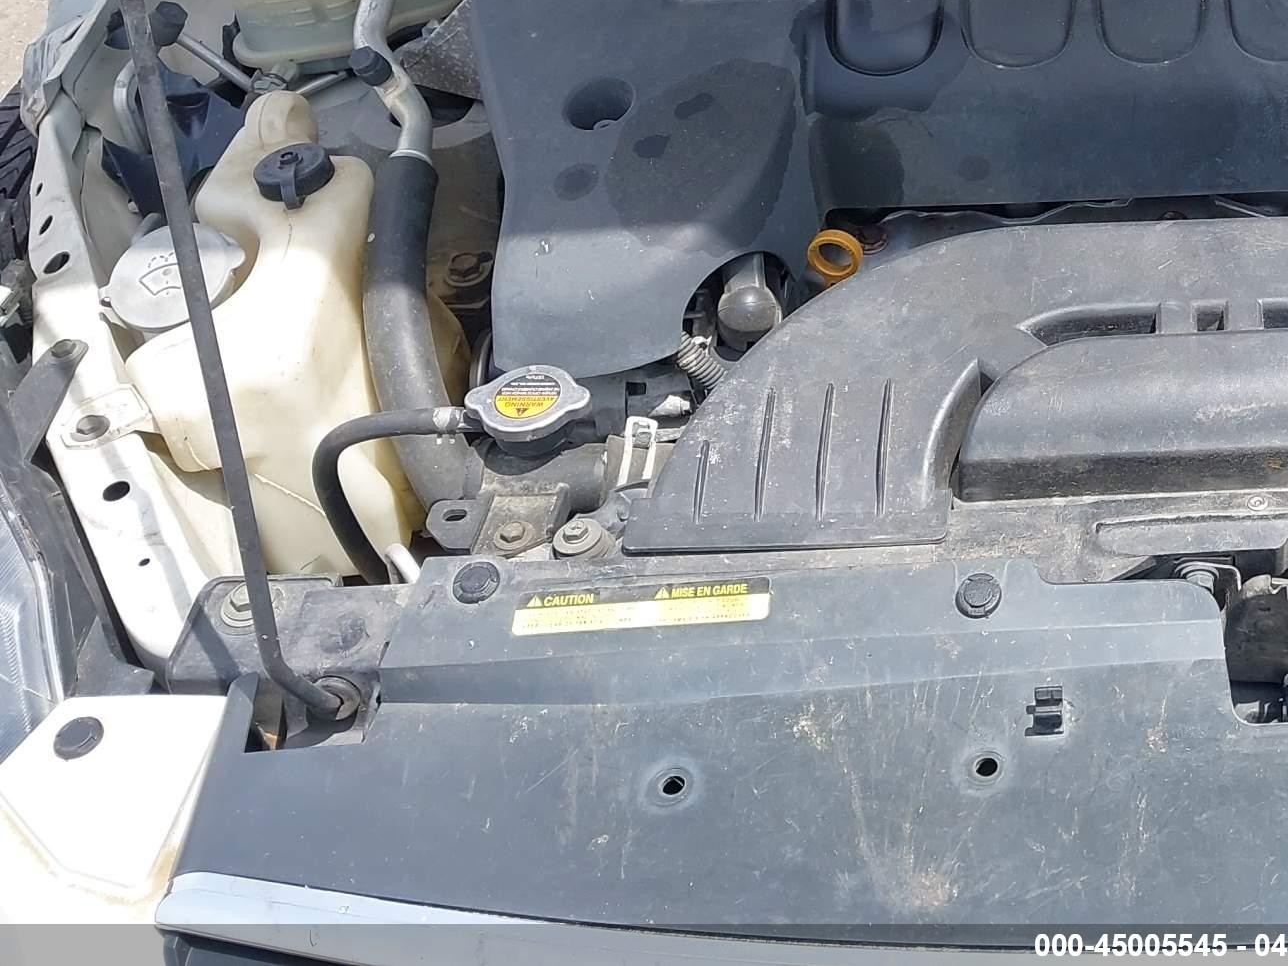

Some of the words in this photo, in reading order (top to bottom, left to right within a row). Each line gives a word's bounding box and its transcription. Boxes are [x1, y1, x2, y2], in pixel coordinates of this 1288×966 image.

[671, 586, 695, 598] MISE
[696, 585, 711, 596] EN
[712, 583, 748, 595] GARDE
[543, 593, 594, 607] CAUTION
